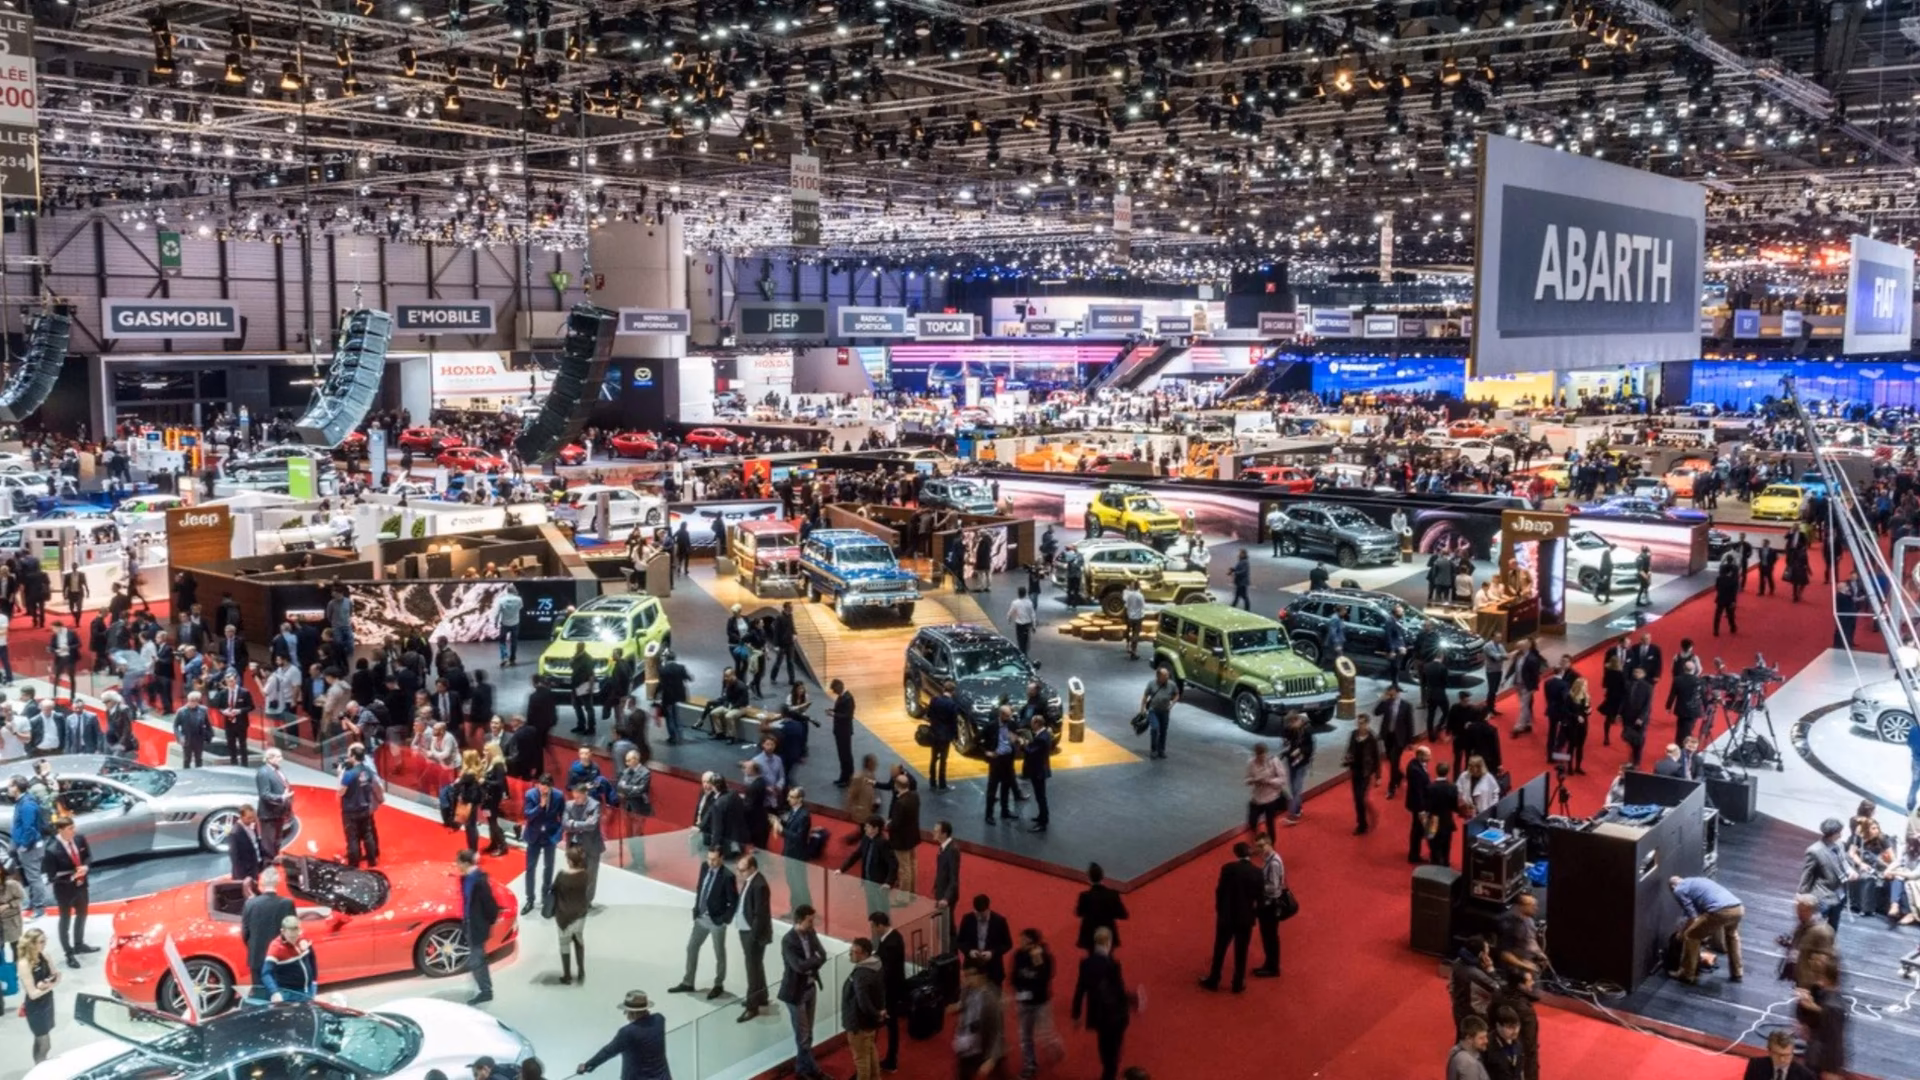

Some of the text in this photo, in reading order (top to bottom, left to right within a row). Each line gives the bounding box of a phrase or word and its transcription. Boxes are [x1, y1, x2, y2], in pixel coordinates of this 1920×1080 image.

[0, 86, 35, 109] 00
[792, 175, 818, 190] 5100
[1534, 224, 1673, 303] ABARTH
[1872, 276, 1897, 320] FIAT
[118, 310, 228, 327] GASMOBIL
[407, 309, 481, 324] E'MOBILE
[767, 312, 799, 332] JEEP
[860, 314, 887, 322] RADICAL
[633, 321, 678, 329] PERFORMANCE
[926, 321, 965, 333] TOPCAR
[441, 365, 497, 376] HONDA
[754, 359, 791, 368] HONDA
[179, 512, 219, 527] Jeep
[1511, 515, 1554, 535] Jeep
[537, 597, 553, 610] 75
